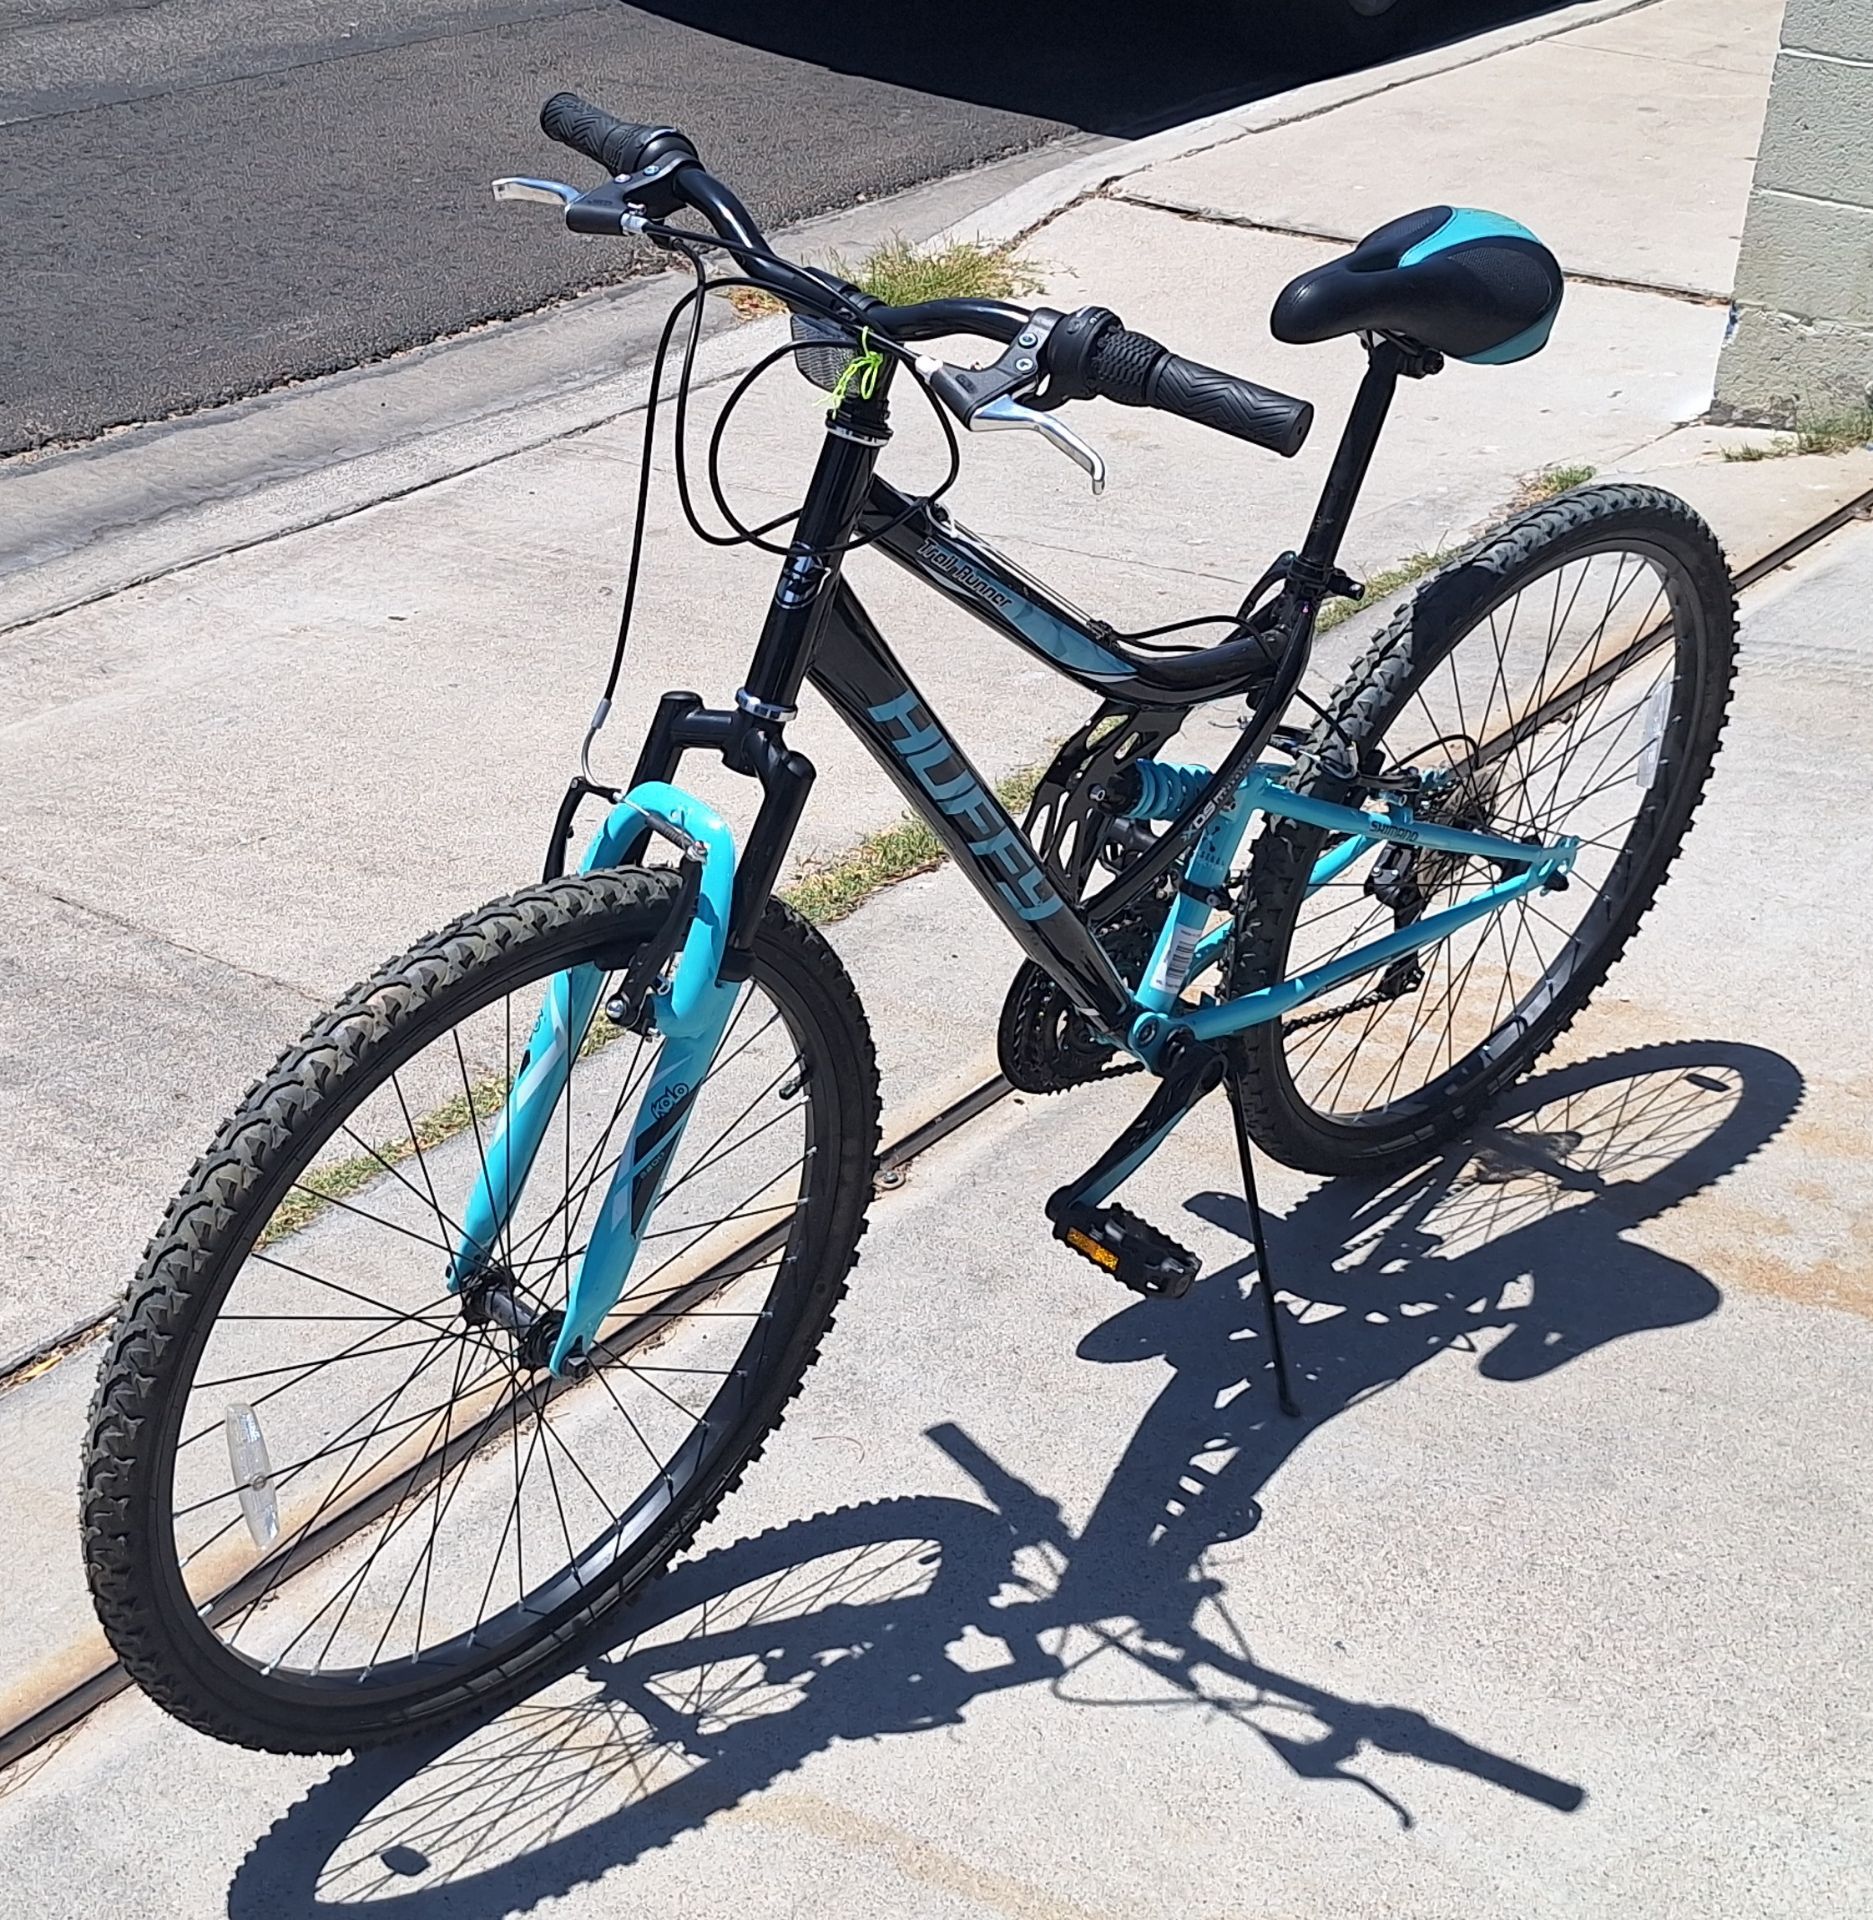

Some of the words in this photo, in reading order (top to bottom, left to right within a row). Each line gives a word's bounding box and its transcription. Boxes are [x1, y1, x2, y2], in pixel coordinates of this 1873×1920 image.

[917, 537, 958, 571] Trail
[951, 564, 1013, 607] Runner
[868, 689, 1063, 920] HUFFY
[1369, 821, 1419, 841] SHIMANO
